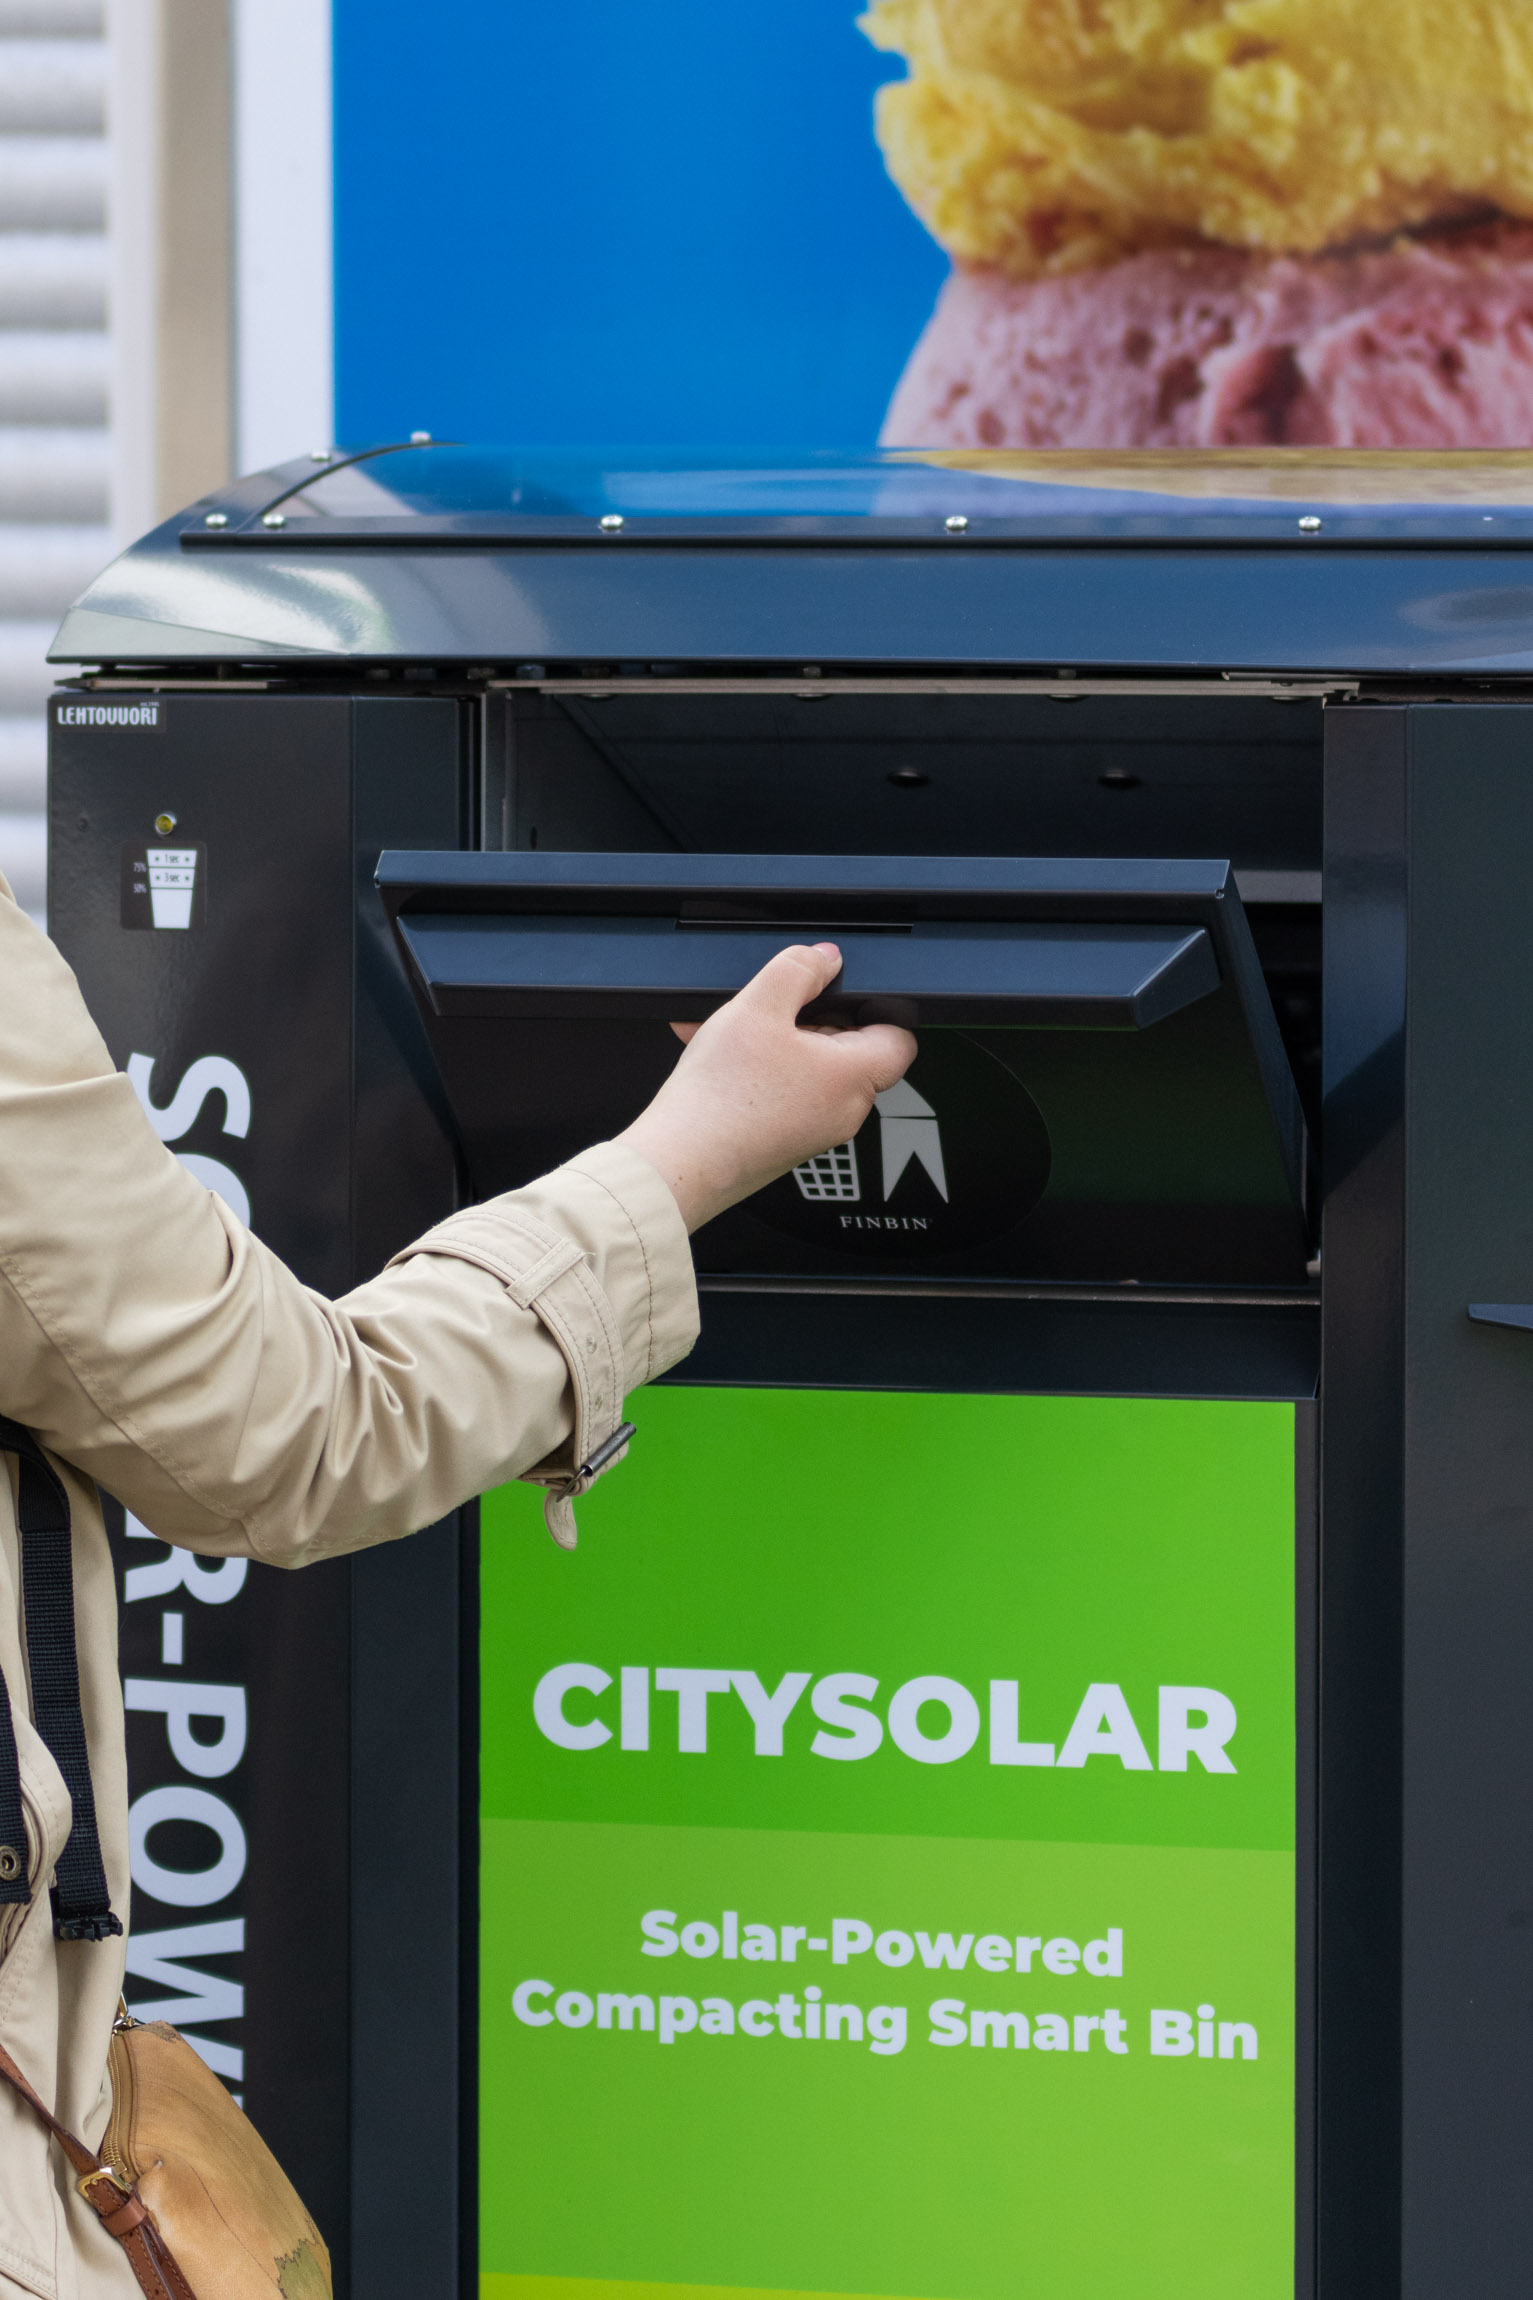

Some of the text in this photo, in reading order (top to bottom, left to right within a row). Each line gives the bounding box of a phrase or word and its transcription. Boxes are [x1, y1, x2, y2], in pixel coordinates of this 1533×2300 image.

[169, 856, 180, 864] sec
[169, 874, 180, 882] sec
[840, 1216, 928, 1230] FINBIN
[532, 1662, 1238, 1775] CITYSOLAR
[640, 1909, 1124, 1978] Solar-Powered
[511, 1979, 1259, 2061] Compacting Smart Bin
